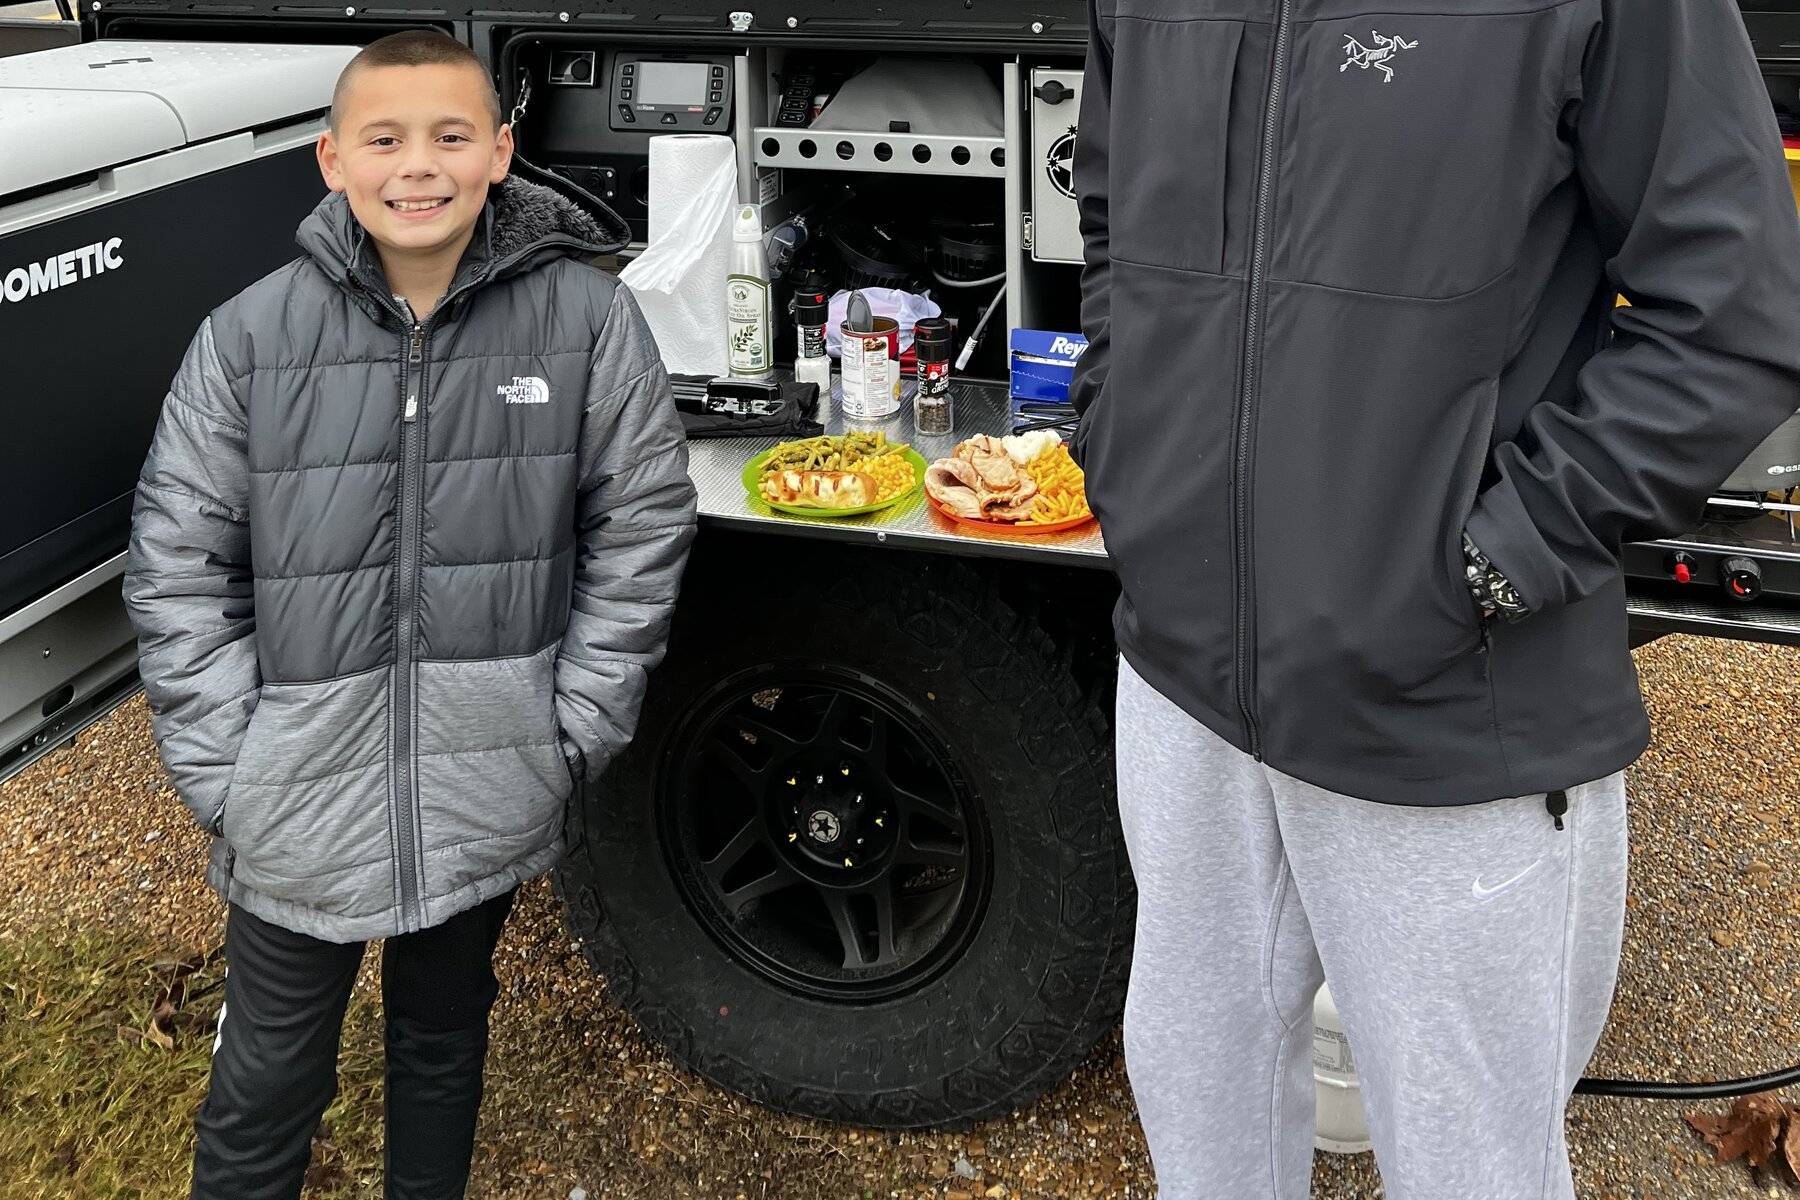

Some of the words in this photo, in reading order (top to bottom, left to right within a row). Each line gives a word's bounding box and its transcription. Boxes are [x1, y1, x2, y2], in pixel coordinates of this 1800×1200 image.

[0, 237, 124, 303] OMETIC
[1049, 336, 1088, 360] Rey
[512, 377, 532, 386] THE
[497, 385, 531, 395] NORTH
[506, 394, 532, 404] FACE
